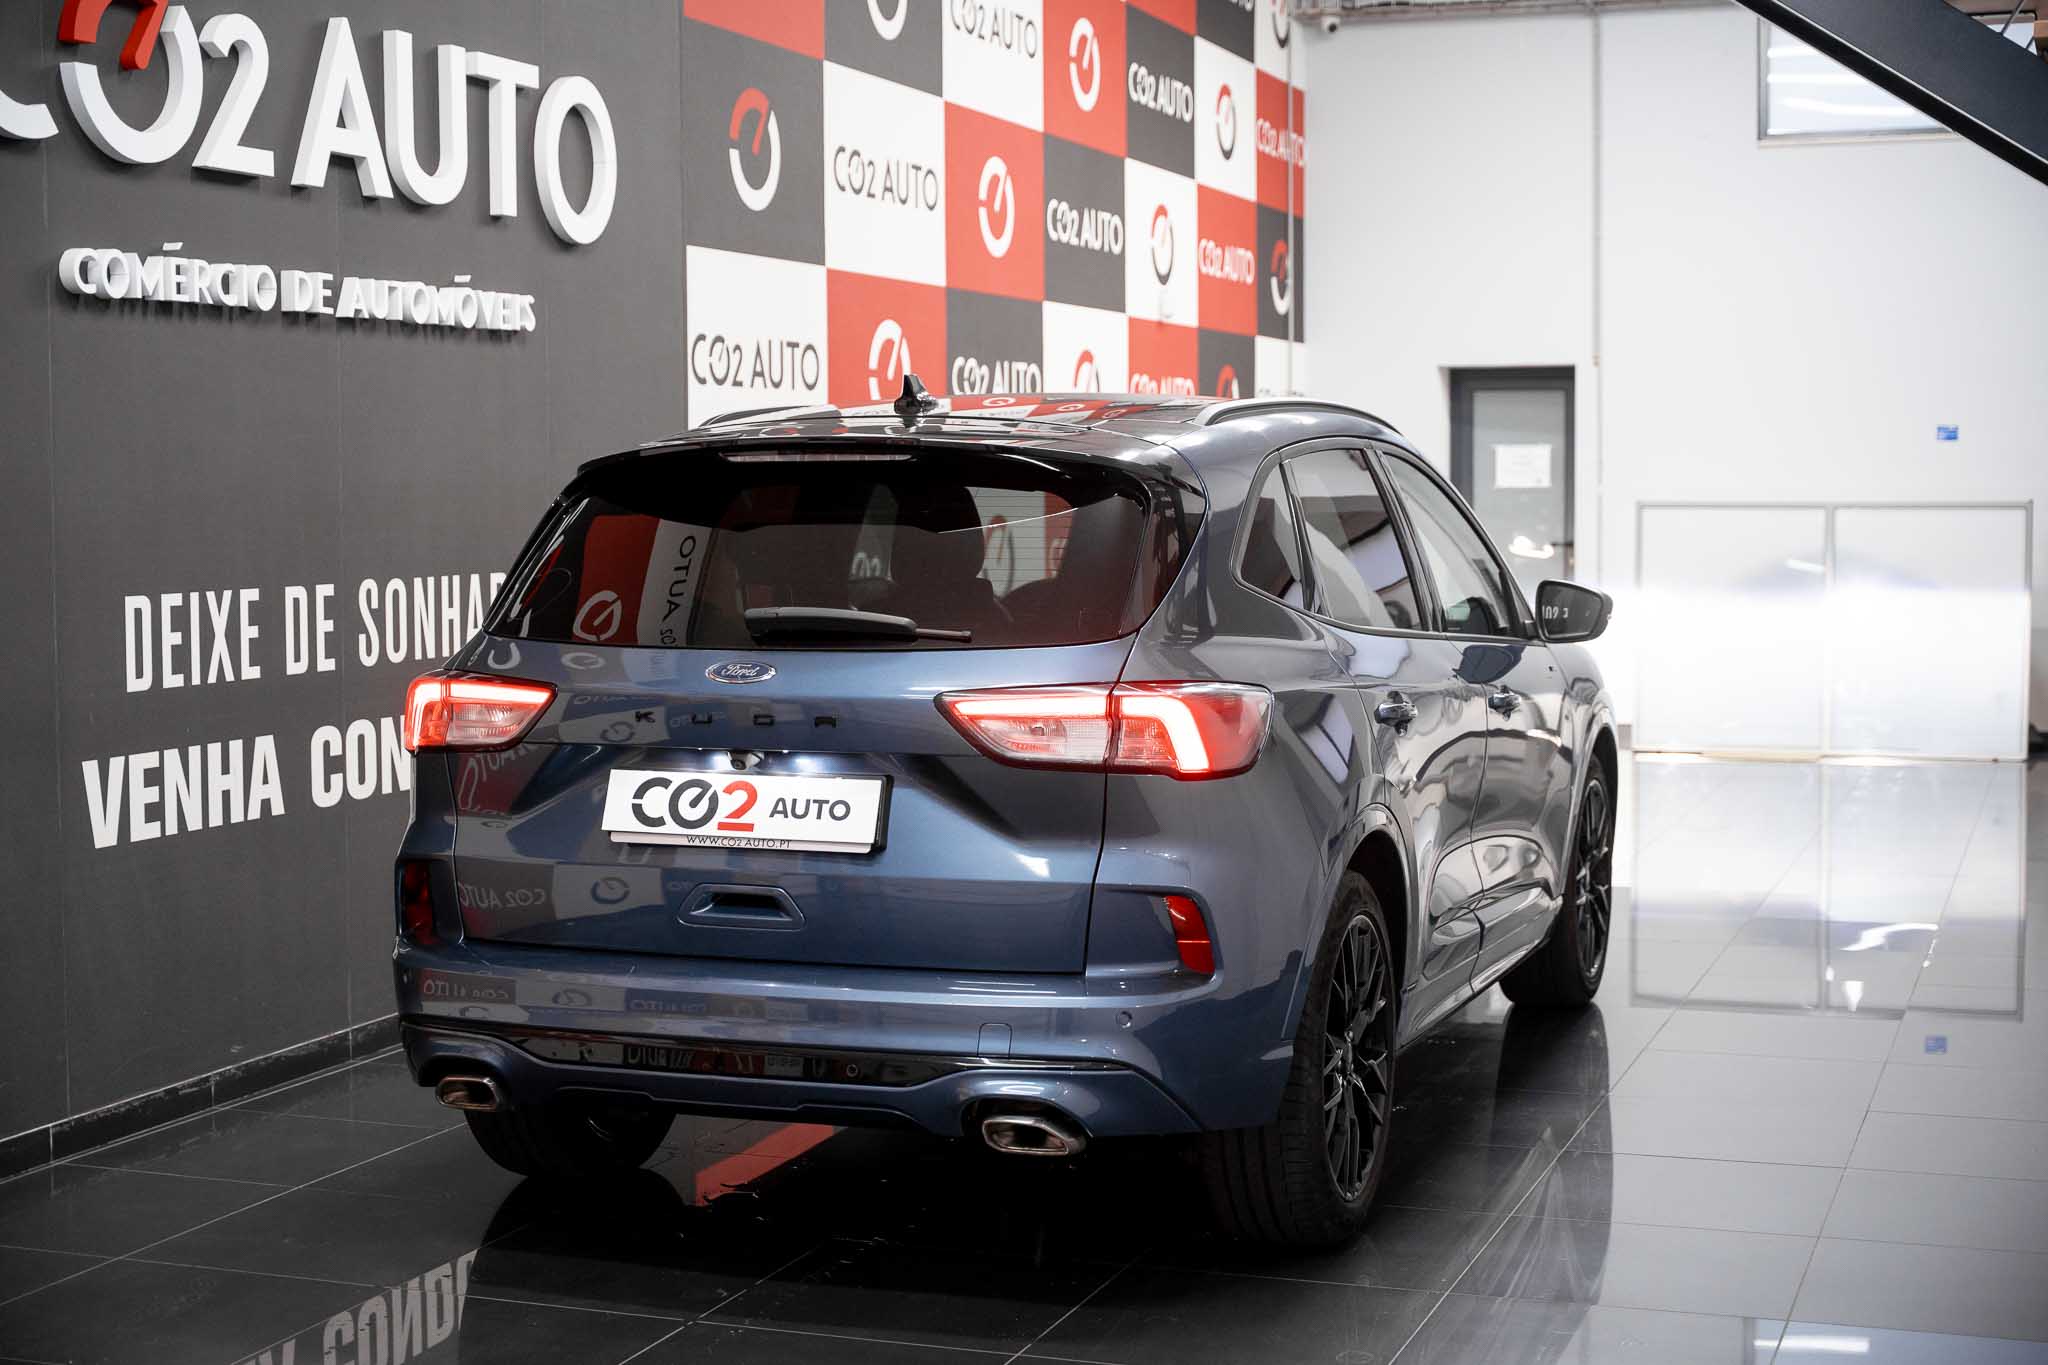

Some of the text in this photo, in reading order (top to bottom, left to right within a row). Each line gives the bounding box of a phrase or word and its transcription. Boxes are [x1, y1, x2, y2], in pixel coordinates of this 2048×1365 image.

[990, 5, 1038, 58] AUTO
[1128, 62, 1194, 123] CO2 AUTO
[0, 0, 618, 245] O2 AUTO
[833, 146, 938, 211] CO2 AUTO
[1047, 198, 1124, 254] CO2 AUTO
[59, 241, 536, 332] COMÉRCIO DE AUTOMÓVEIS
[1198, 238, 1255, 284] CO2 AUTO
[691, 334, 820, 391] CO2 AUTO
[991, 360, 1042, 394] AUTO
[124, 588, 261, 693] DEIXE
[285, 584, 336, 676] DE
[718, 663, 760, 678] Ford
[82, 735, 286, 849] VENHA
[631, 776, 851, 833] CO2 AUTO
